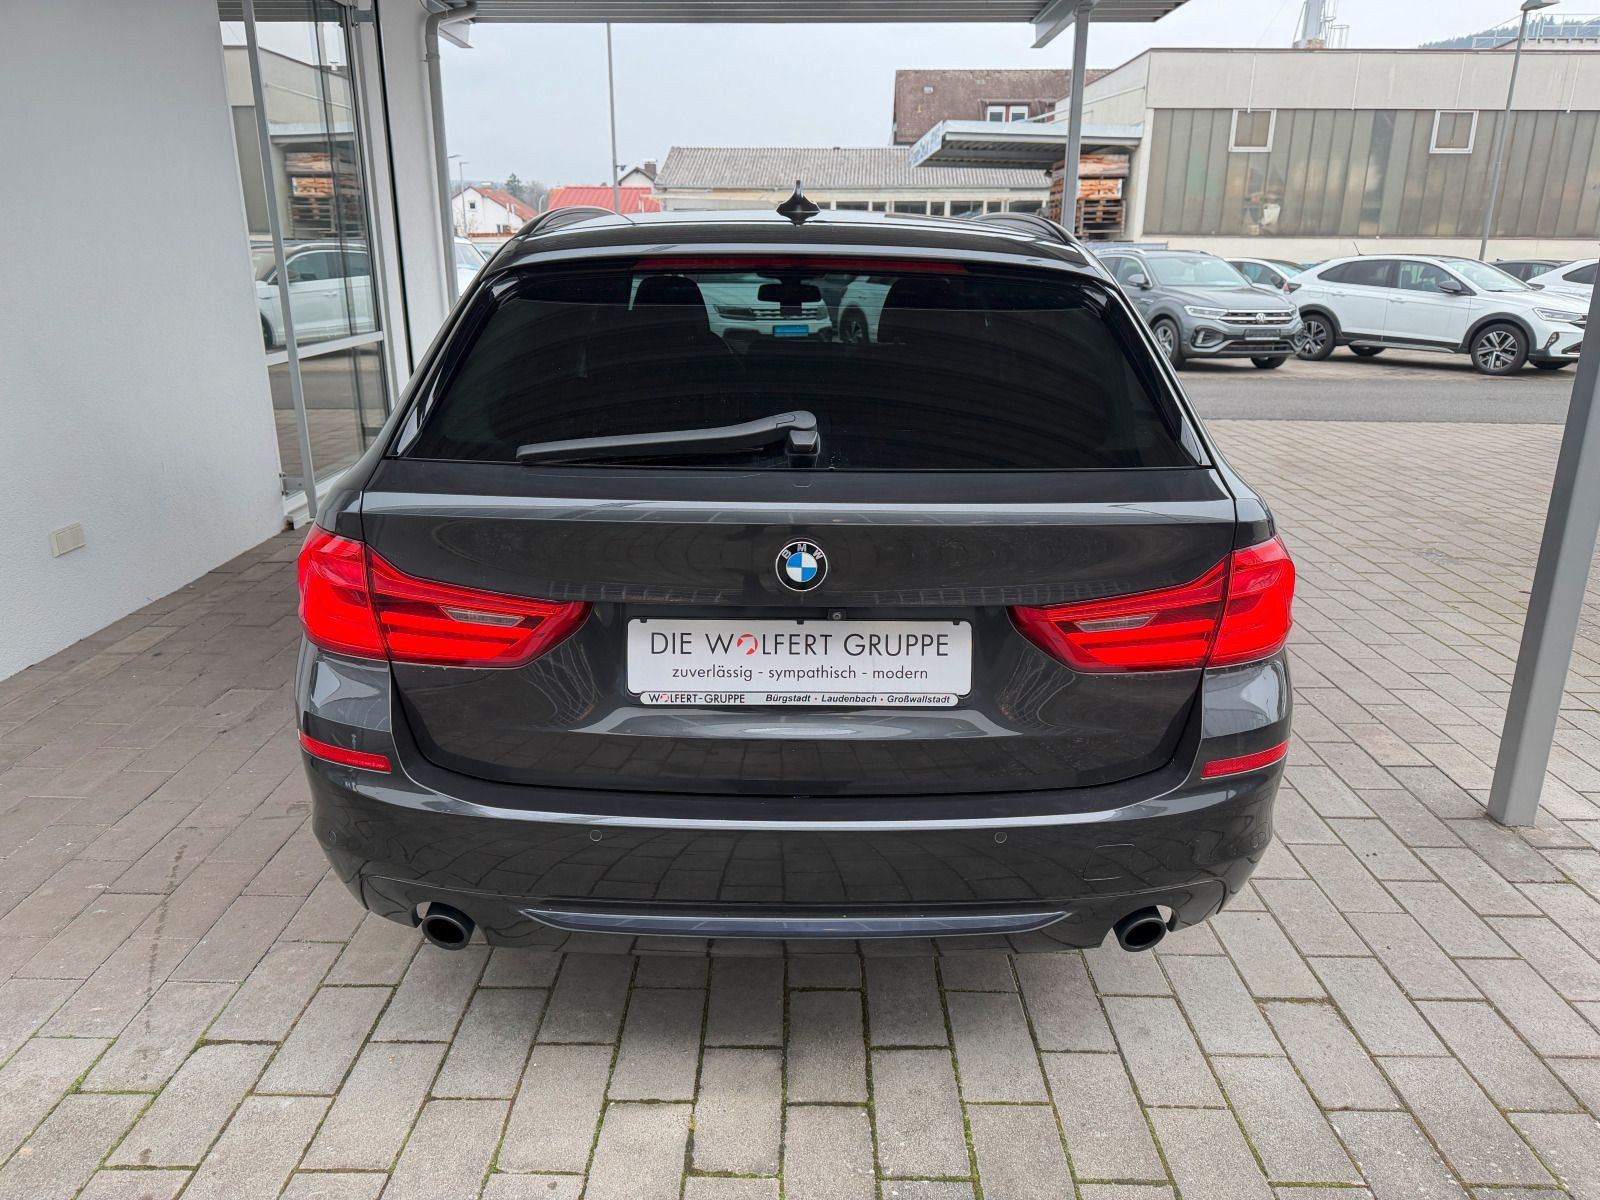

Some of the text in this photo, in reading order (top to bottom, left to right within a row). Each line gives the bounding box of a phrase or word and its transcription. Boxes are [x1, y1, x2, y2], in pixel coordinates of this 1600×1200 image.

[781, 544, 823, 560] BMW
[651, 632, 949, 657] DIE WOLFERT GRUPPE
[672, 664, 752, 681] zuverlässig
[768, 664, 856, 681] sympathisch
[872, 665, 928, 679] modern
[765, 693, 811, 704] Bürgstadt
[821, 694, 877, 703] Laudenbach
[886, 694, 951, 704] Großwallstadt
